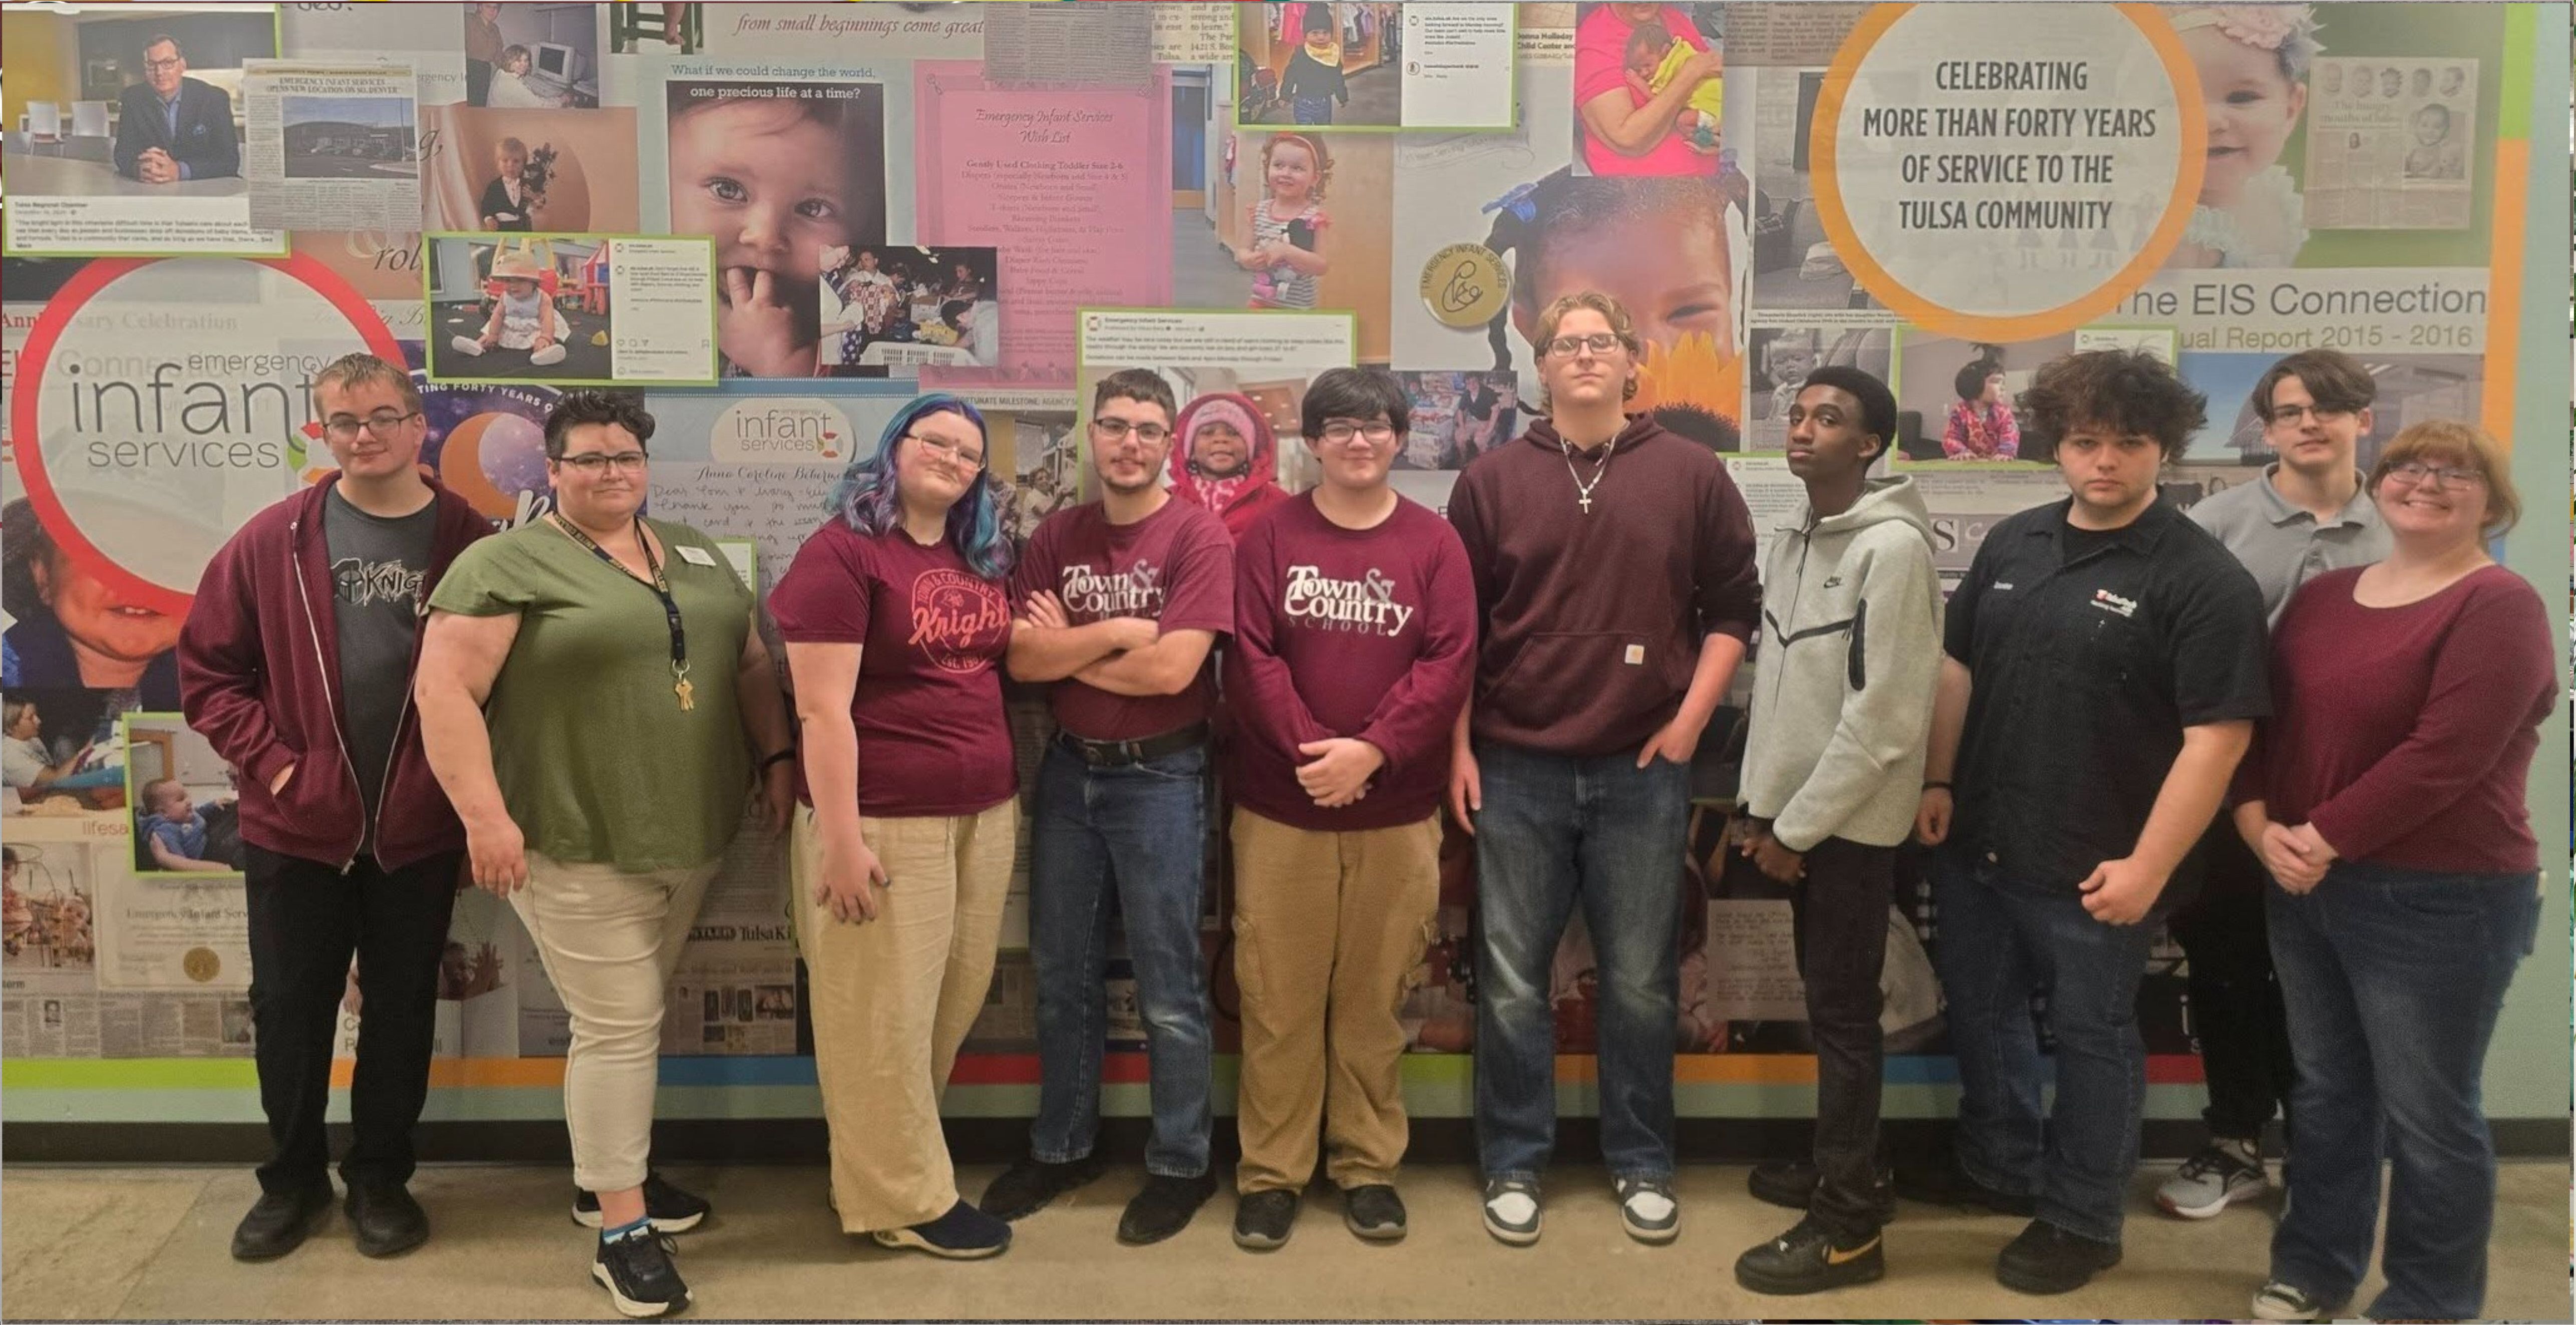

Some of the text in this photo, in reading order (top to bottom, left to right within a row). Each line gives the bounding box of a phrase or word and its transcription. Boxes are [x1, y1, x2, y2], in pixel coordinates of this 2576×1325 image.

[734, 14, 984, 39] from small beginnings come great
[672, 64, 701, 75] What
[704, 65, 713, 75] if
[736, 65, 769, 76] could
[771, 66, 816, 79] change
[818, 66, 836, 77] the
[838, 67, 875, 80] world,
[1937, 62, 2087, 90] CELEBRATING
[690, 88, 716, 97] one
[718, 86, 774, 99] precious
[776, 86, 798, 97] life
[800, 89, 813, 98] at
[826, 87, 860, 99] time?
[977, 108, 1114, 127] Emergency Infant Services
[1863, 109, 2155, 137] MORE THAN FORTY YEARS
[1019, 129, 1071, 143] Wish List
[967, 160, 994, 169] Gently
[1020, 161, 1056, 170] Clothing
[1058, 161, 1090, 169] Toddler
[1902, 155, 2113, 183] OF SERVICE TO THE
[1899, 201, 2112, 229] TULSA COMMUNITY
[1455, 244, 1486, 255] INFANT
[2193, 283, 2255, 316] EIS
[2271, 282, 2486, 316] Connection
[2227, 326, 2311, 353] Report
[2321, 325, 2382, 348] 2015
[2410, 324, 2472, 347] 2016
[189, 354, 331, 376] emergency
[70, 362, 314, 453] infant
[453, 384, 496, 393] FORTY
[501, 388, 541, 406] YEARS
[736, 409, 831, 446] infant
[88, 441, 280, 469] services
[741, 438, 815, 451] services
[941, 573, 997, 598] COUNTRY
[1062, 558, 1160, 598] Town &
[1286, 565, 1396, 605] Town &
[1063, 581, 1166, 617] Country
[1284, 580, 1414, 637] Country
[908, 596, 1008, 648] Knight
[1287, 616, 1386, 635] SCHOOL
